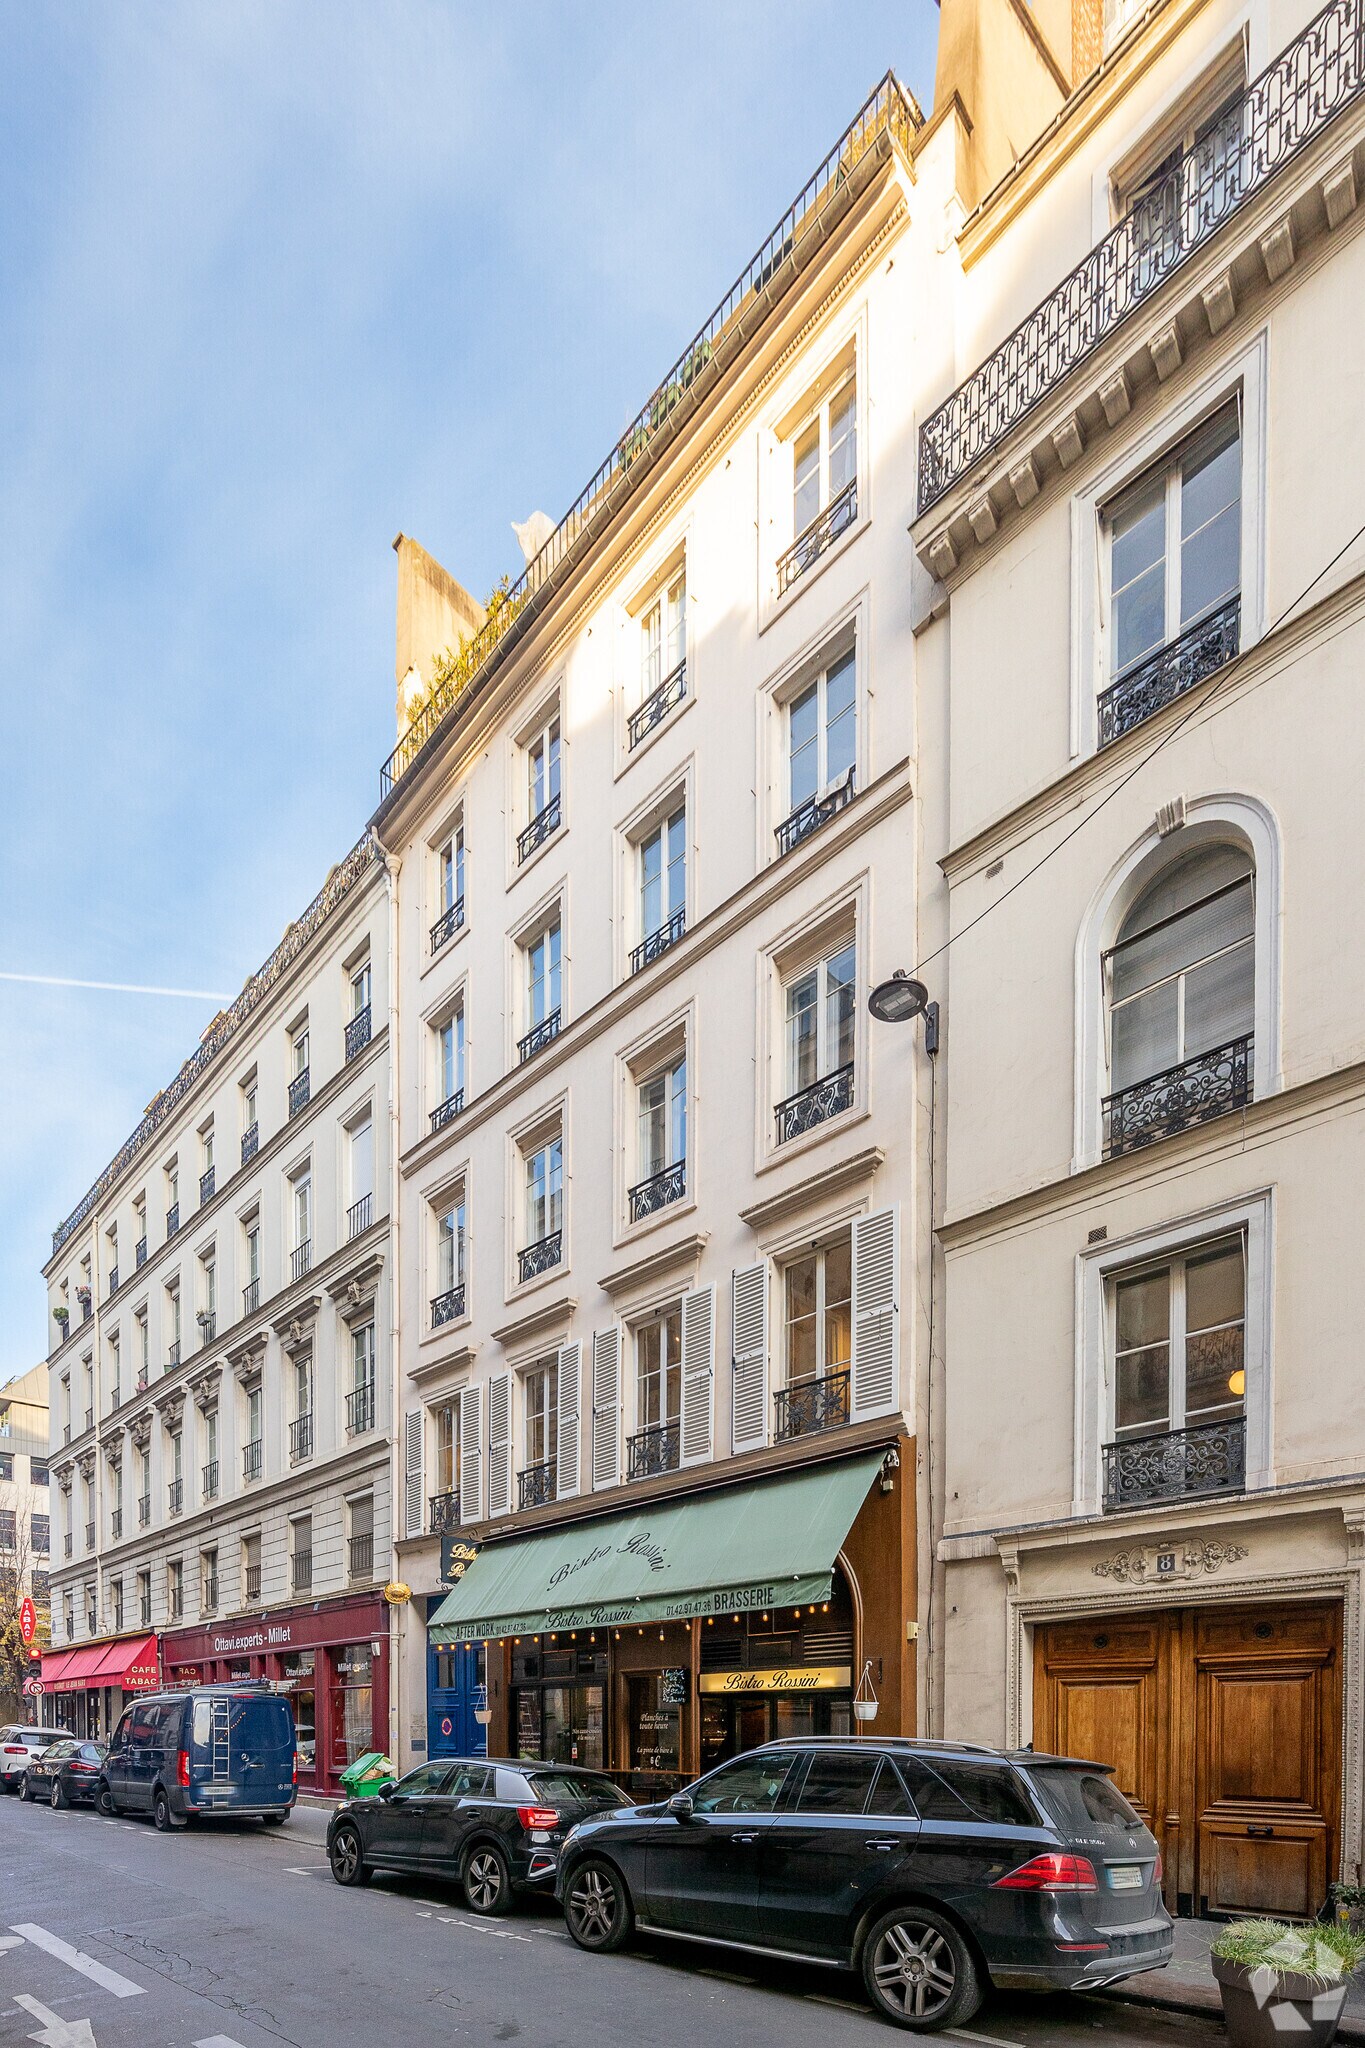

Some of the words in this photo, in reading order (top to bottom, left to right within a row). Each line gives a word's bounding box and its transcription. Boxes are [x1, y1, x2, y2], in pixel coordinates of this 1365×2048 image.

[546, 1546, 612, 1592] Bistro
[616, 1532, 672, 1572] Rossini
[1160, 1555, 1171, 1570] 8
[714, 1587, 774, 1610] BRASSERIE
[23, 1602, 31, 1637] TABAC
[545, 1611, 584, 1628] Bistro
[586, 1606, 634, 1624] Rossini
[214, 1632, 263, 1651] Ottavi.experts
[268, 1626, 290, 1644] Millet
[456, 1625, 475, 1639] AFTER
[476, 1622, 494, 1636] WORK
[723, 1673, 764, 1690] Bistro
[768, 1670, 821, 1688] Rossini
